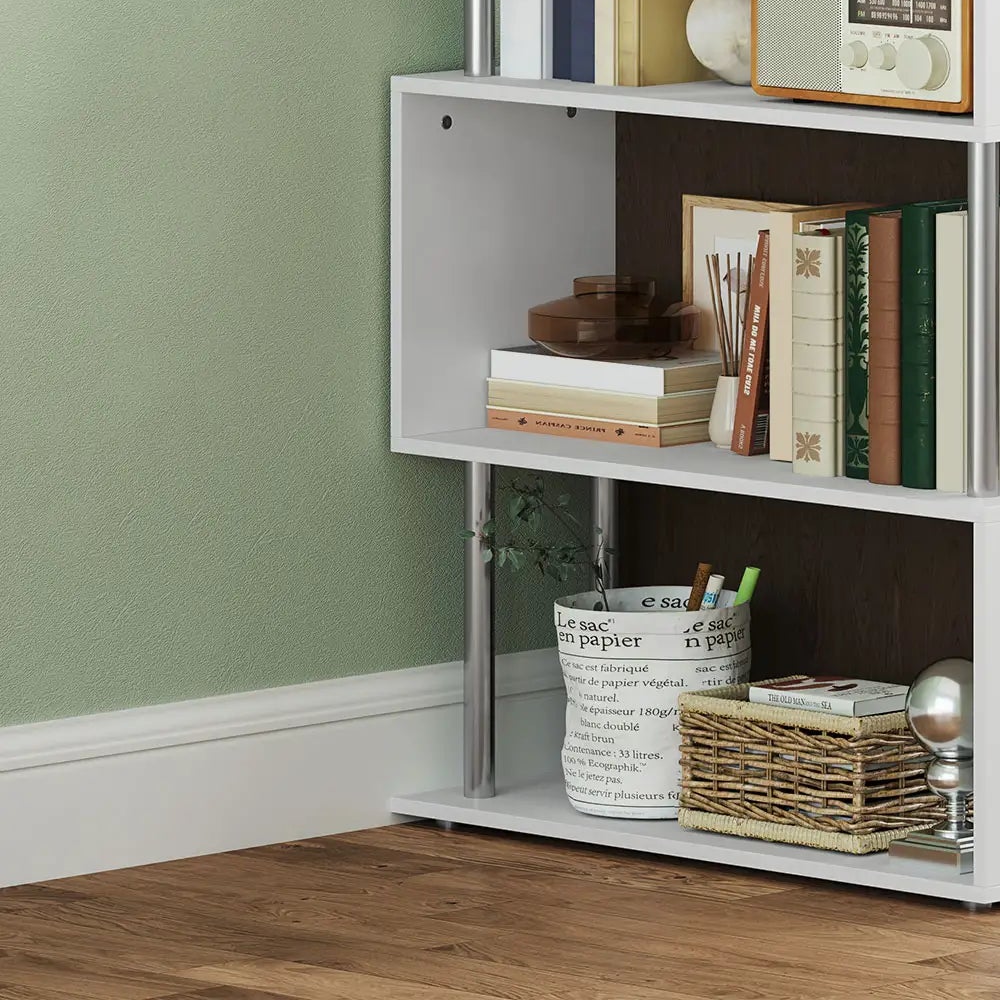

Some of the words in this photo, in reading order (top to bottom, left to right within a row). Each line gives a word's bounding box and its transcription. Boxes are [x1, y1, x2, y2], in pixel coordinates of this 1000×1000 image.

[557, 612, 576, 629] Le
[559, 631, 575, 643] en
[579, 633, 642, 651] papier
[705, 627, 746, 651] papier
[572, 661, 584, 670] sac
[585, 664, 598, 672] est
[600, 663, 649, 675] fabriqué
[695, 664, 718, 673] sac
[588, 677, 599, 686] de
[601, 679, 639, 689] papier
[642, 678, 688, 689] végétal.
[583, 693, 619, 702] naturel.
[768, 694, 779, 702] THE
[780, 695, 792, 704] OLD
[793, 697, 806, 706] MAN
[821, 701, 832, 710] SEA
[589, 707, 635, 717] épaisseur
[580, 718, 601, 729] blanc
[603, 721, 640, 731] doublé
[591, 733, 615, 744] brun
[619, 750, 630, 759] 33
[632, 750, 664, 760] litres.
[565, 768, 577, 777] Ne
[585, 771, 605, 782] jetez
[588, 787, 612, 799] servir
[614, 790, 665, 800] plusieurs
